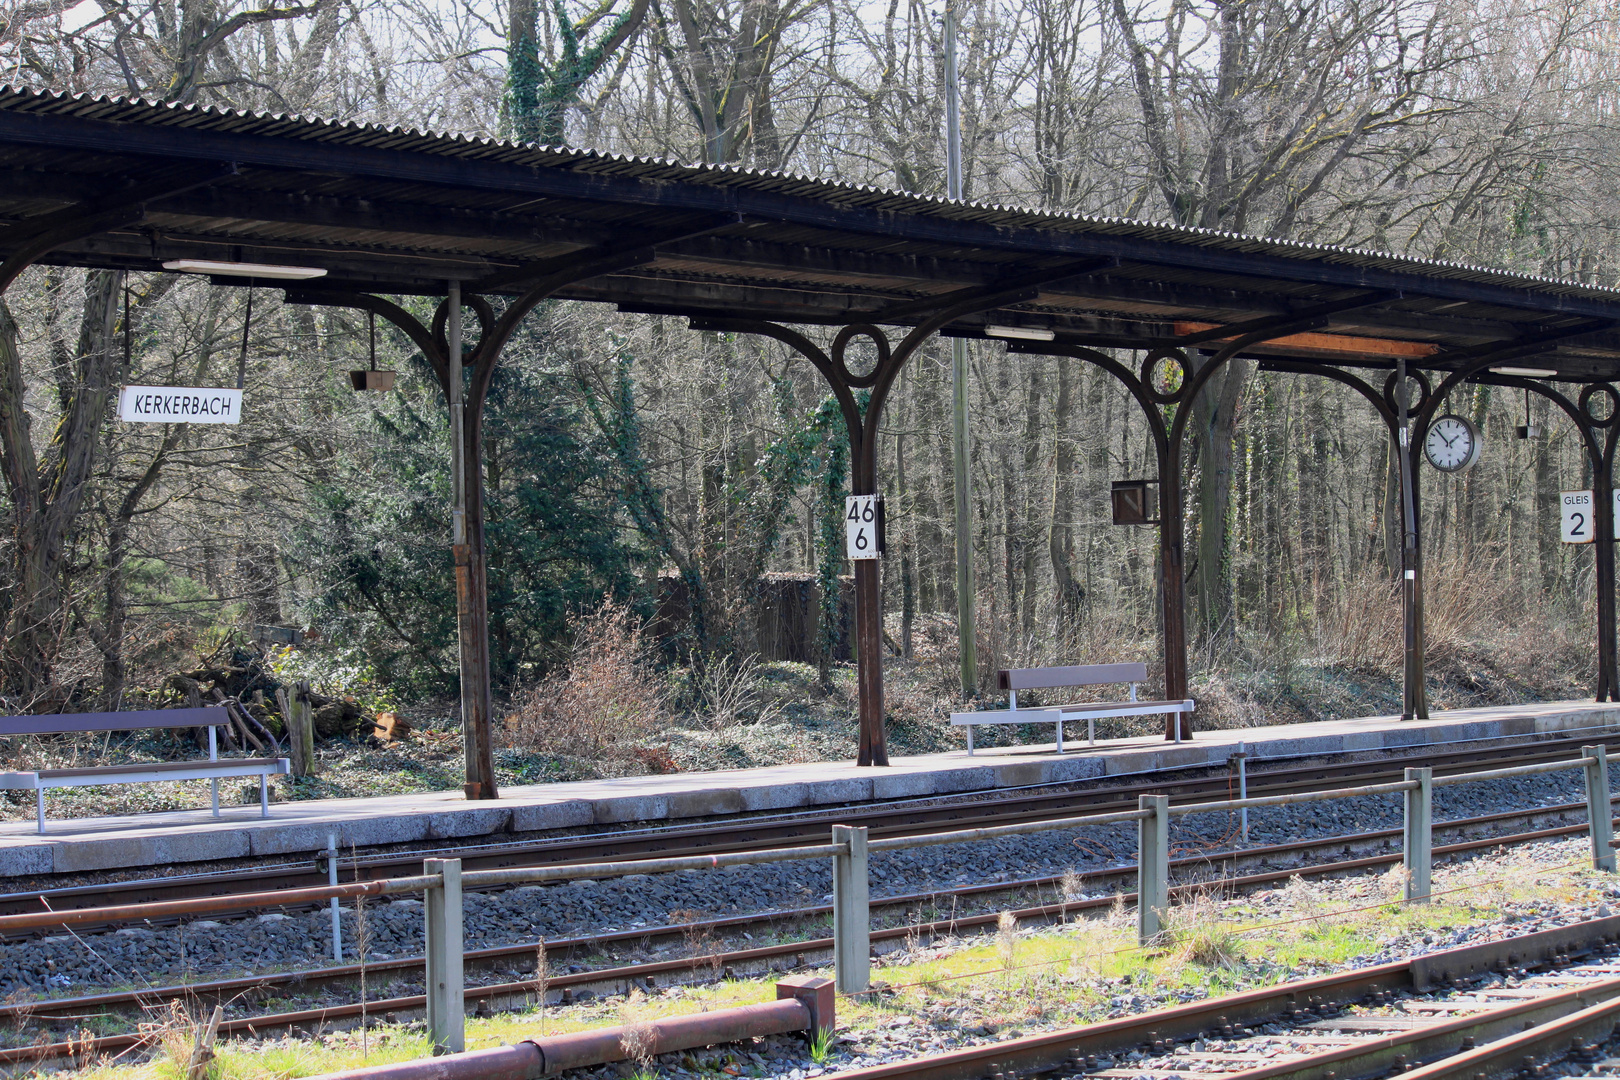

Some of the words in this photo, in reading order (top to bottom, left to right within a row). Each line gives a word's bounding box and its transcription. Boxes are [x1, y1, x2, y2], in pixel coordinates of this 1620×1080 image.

[134, 394, 231, 416] KERKERBACH
[847, 500, 874, 523] 46
[1564, 495, 1589, 505] GLEIS
[1570, 512, 1585, 536] 2
[855, 527, 868, 550] 6
